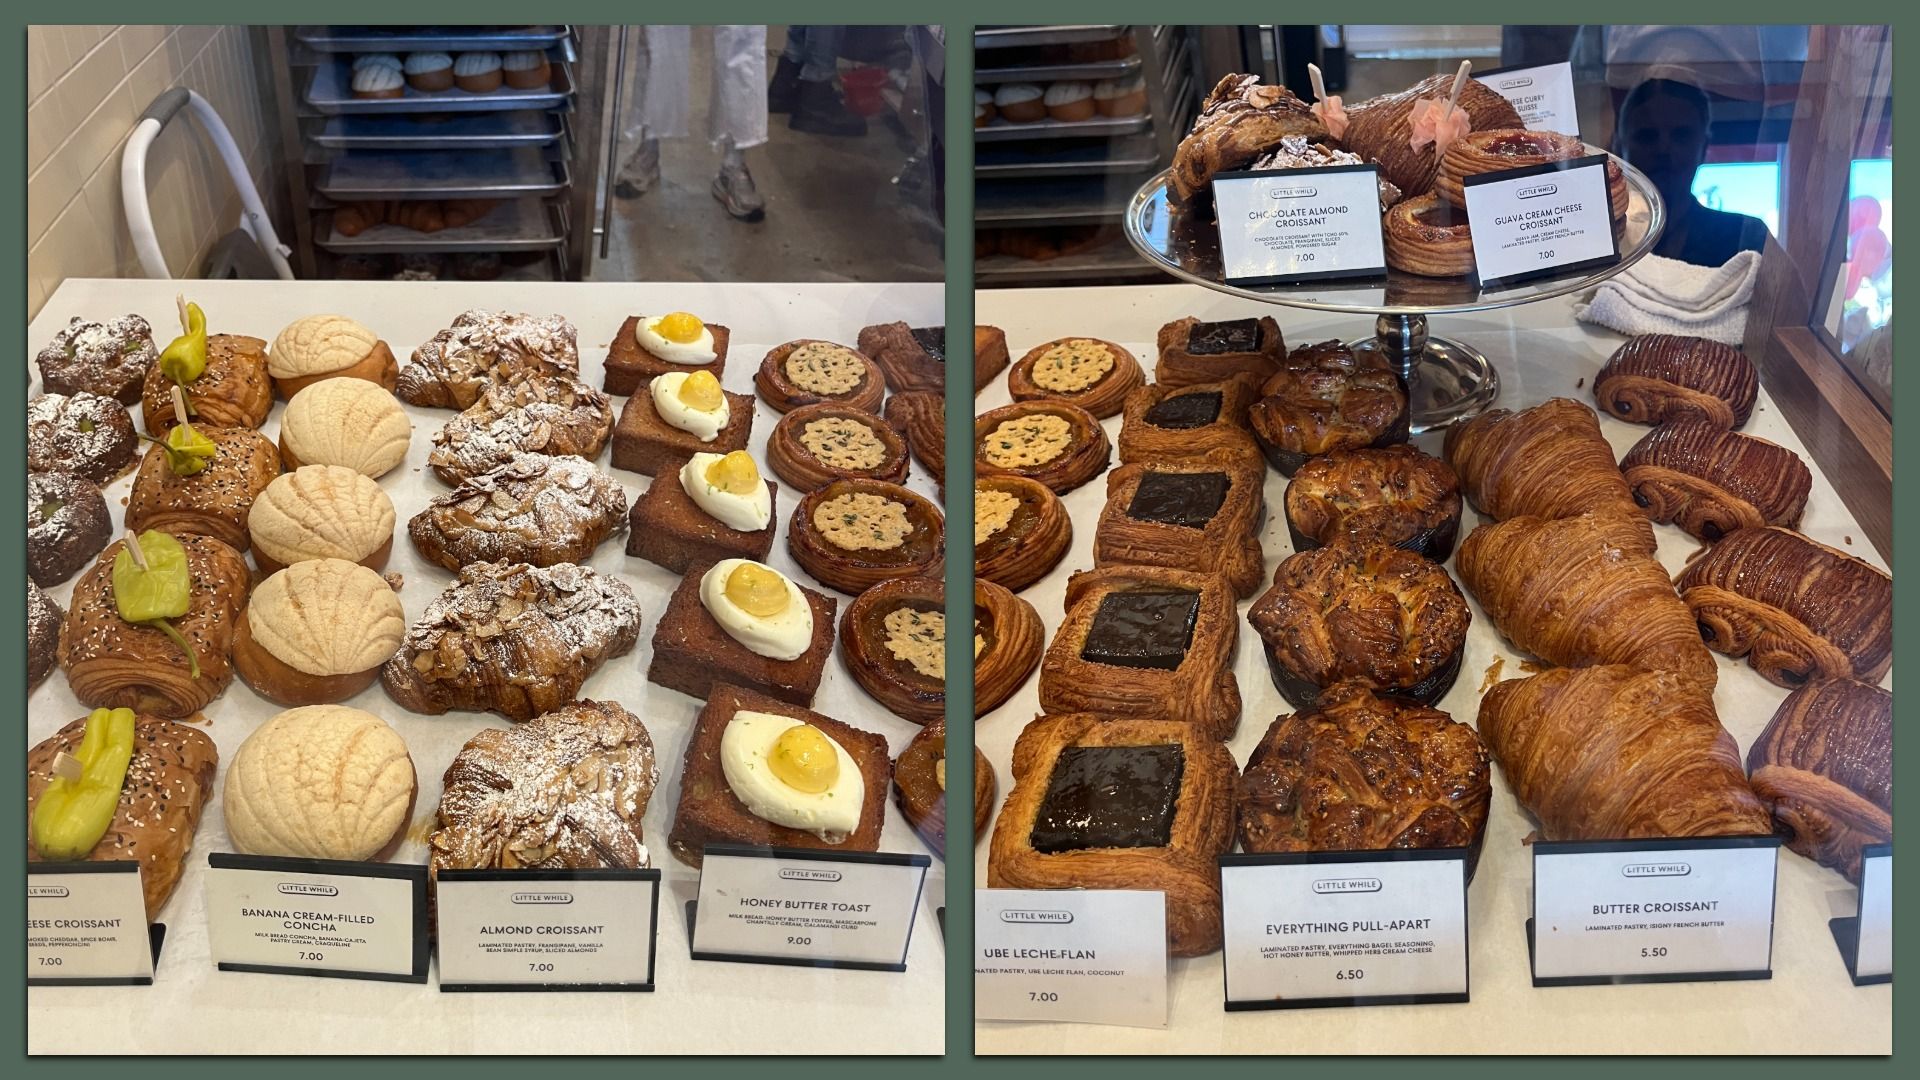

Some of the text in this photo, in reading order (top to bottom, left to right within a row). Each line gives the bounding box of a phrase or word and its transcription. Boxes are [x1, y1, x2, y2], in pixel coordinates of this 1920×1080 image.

[1524, 94, 1545, 103] CURRY
[1517, 103, 1538, 112] SUISSE
[1519, 186, 1554, 197] LITTLE WHILE
[1249, 205, 1349, 220] CHOCOLATE ALMOND
[1494, 203, 1583, 226] GUAVA CREAM CHEESE
[1275, 217, 1327, 228] CROISSANT
[1519, 216, 1564, 231] CROISSANT
[1502, 241, 1524, 249] LAMINATED
[1296, 253, 1315, 262] 7.00
[1538, 250, 1555, 260] 7.00
[1627, 865, 1686, 874] LITTLE WHILE
[783, 870, 837, 880] LITTLE WHILE
[1317, 880, 1377, 890] LITTLE WHILE
[740, 898, 871, 913] HONEY BUTTER TOAST
[1593, 901, 1719, 915] BUTTER CROISSANT
[242, 908, 375, 924] BANANA CREAM-FILLED
[54, 919, 121, 928] CROISSANT
[283, 921, 337, 932] CONCHA
[1266, 918, 1431, 935] EVERYTHING PULL-APART
[480, 925, 604, 935] ALMOND CROISSANT
[787, 936, 812, 945] 9.00
[984, 948, 1096, 960] UBE LECHE FLAN
[1260, 945, 1300, 953] LAMINATED
[1641, 947, 1667, 958] 5.50
[299, 952, 323, 960] 7.00
[38, 958, 62, 966] 7.00
[529, 963, 554, 972] 7.00
[1336, 969, 1364, 980] 6.50
[1029, 992, 1058, 1002] 7.00
